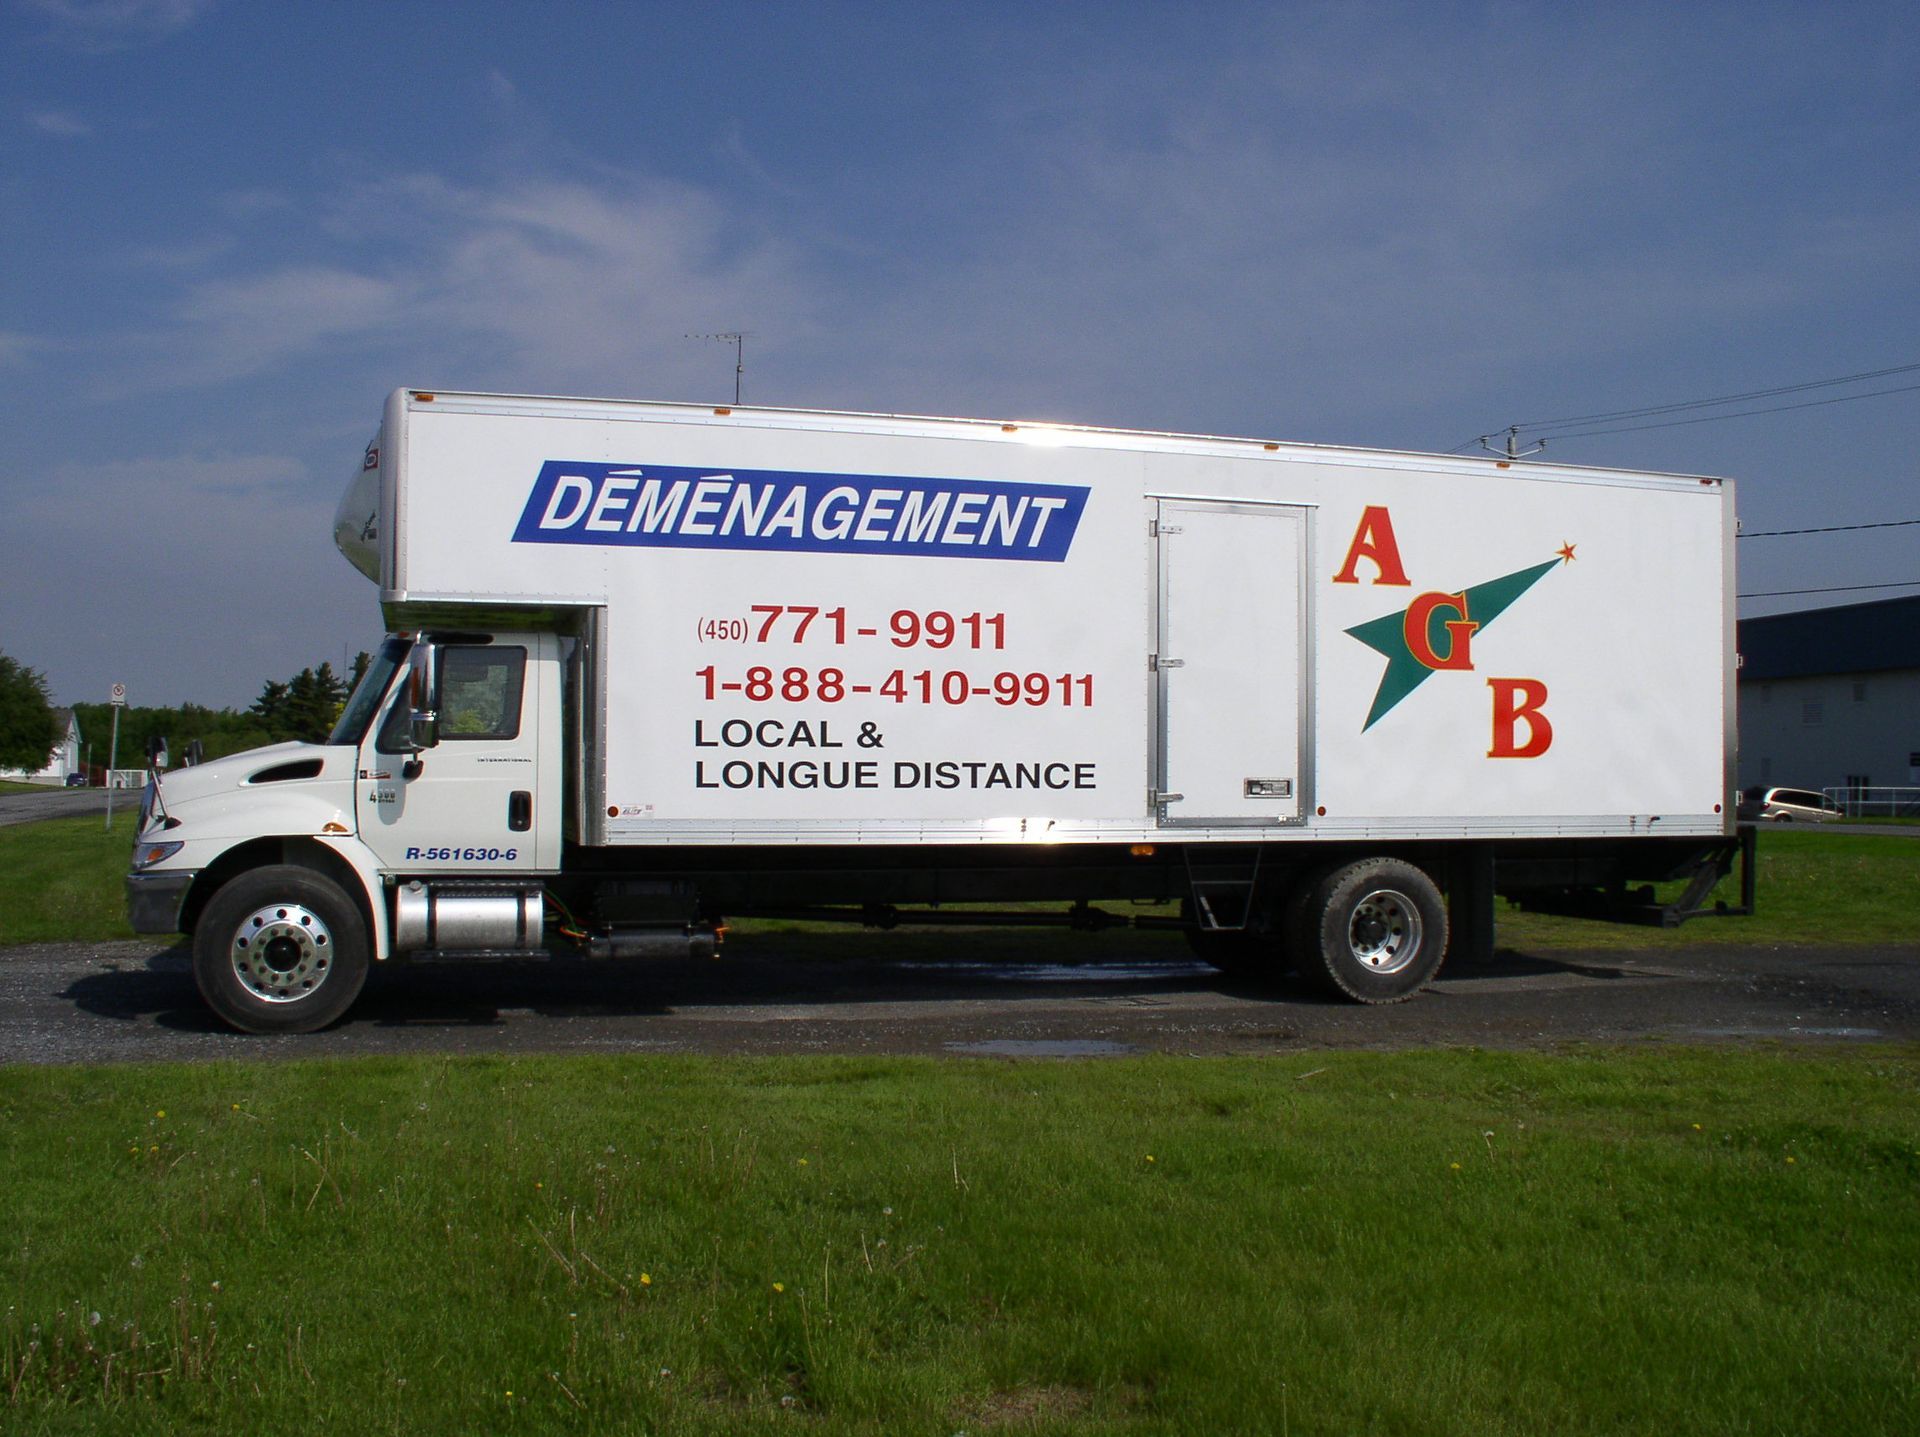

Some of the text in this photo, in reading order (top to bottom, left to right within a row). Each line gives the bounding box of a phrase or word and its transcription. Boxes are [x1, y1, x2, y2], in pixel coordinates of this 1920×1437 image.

[539, 469, 1067, 548] DÉMÉNAGEMENT
[696, 665, 1093, 707] 1-888-410-9911
[695, 719, 885, 749] LOCAL &
[696, 761, 1097, 790] LONGUE DISTANCE
[405, 847, 518, 861] R-561630-6
